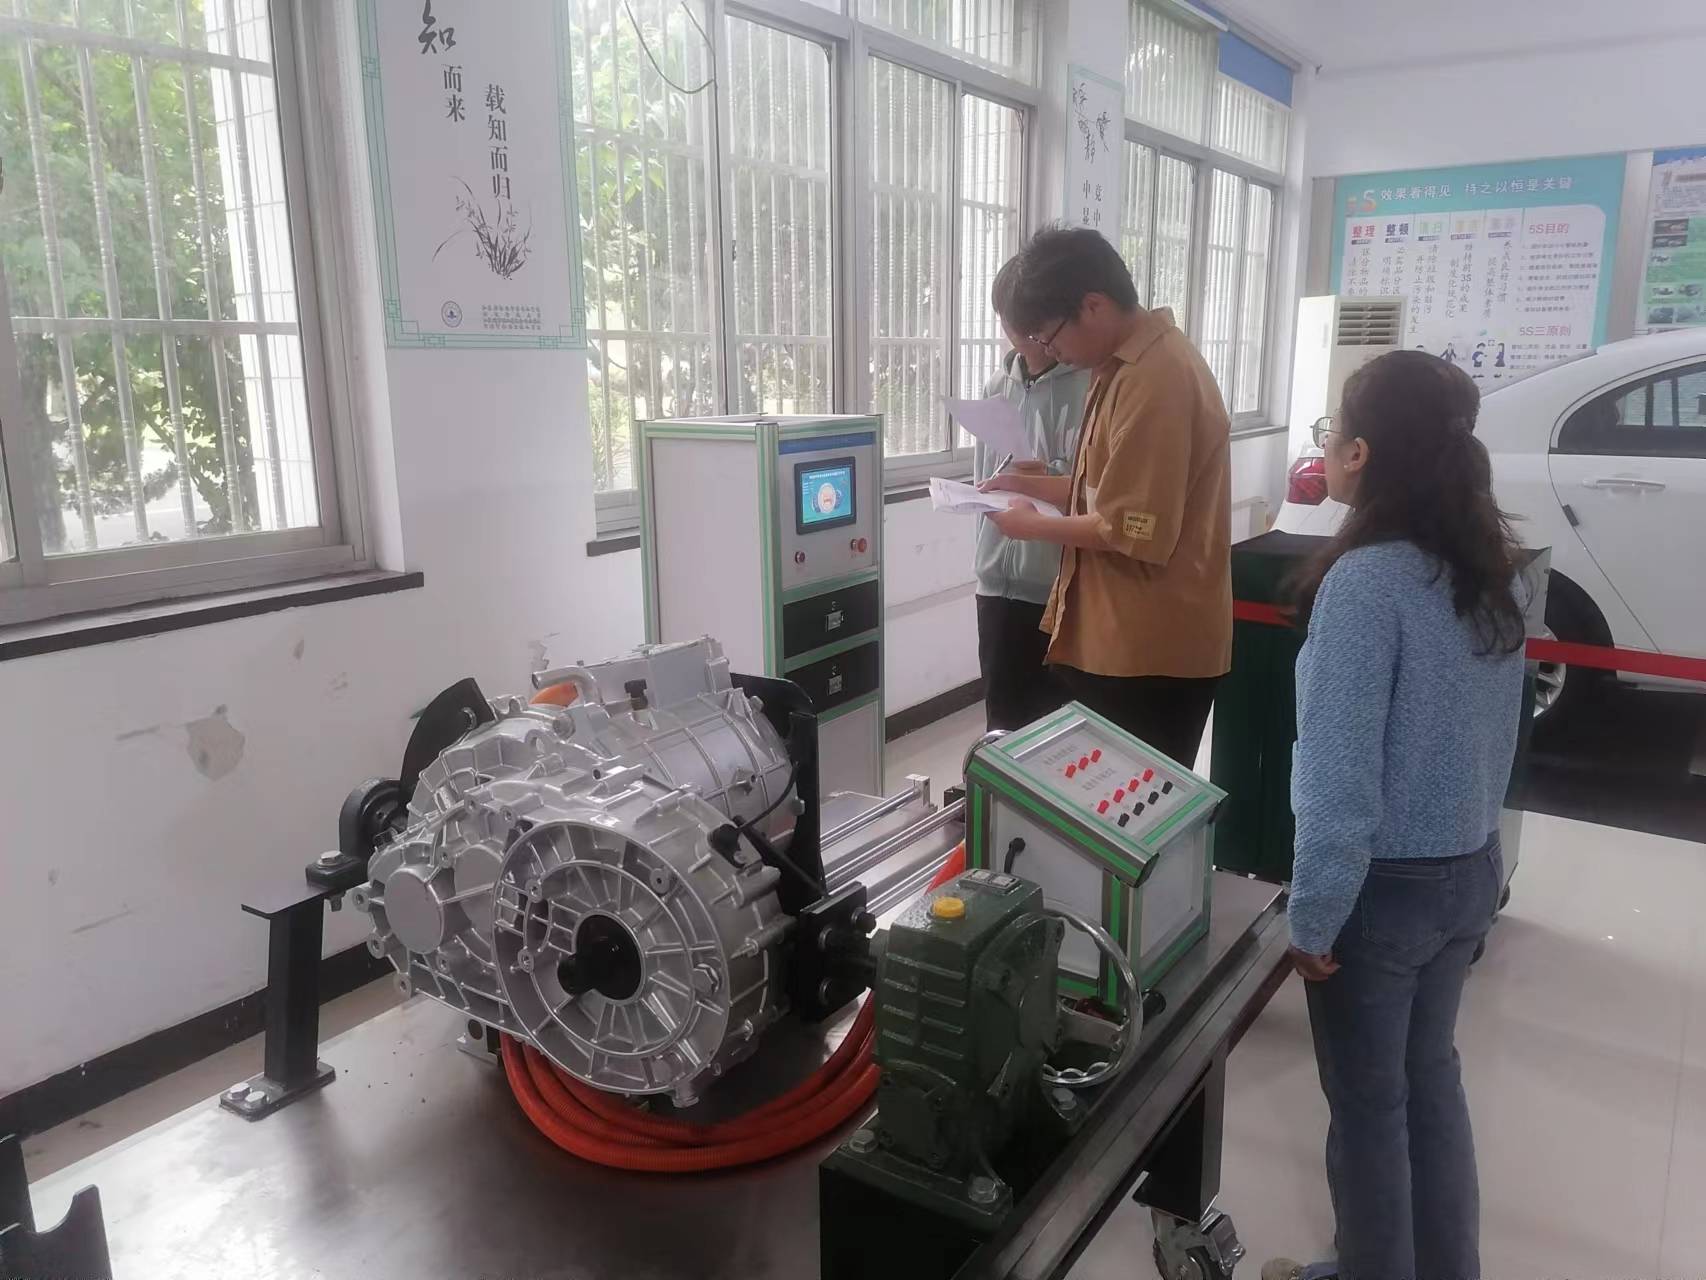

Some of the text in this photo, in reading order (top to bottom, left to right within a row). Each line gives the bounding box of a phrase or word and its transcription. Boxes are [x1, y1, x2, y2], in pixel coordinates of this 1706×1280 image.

[485, 83, 511, 200] 载知而归
[1381, 184, 1451, 200] 效果看得见
[1529, 223, 1569, 234] 5S目的
[1519, 324, 1572, 337] 5S三原则
